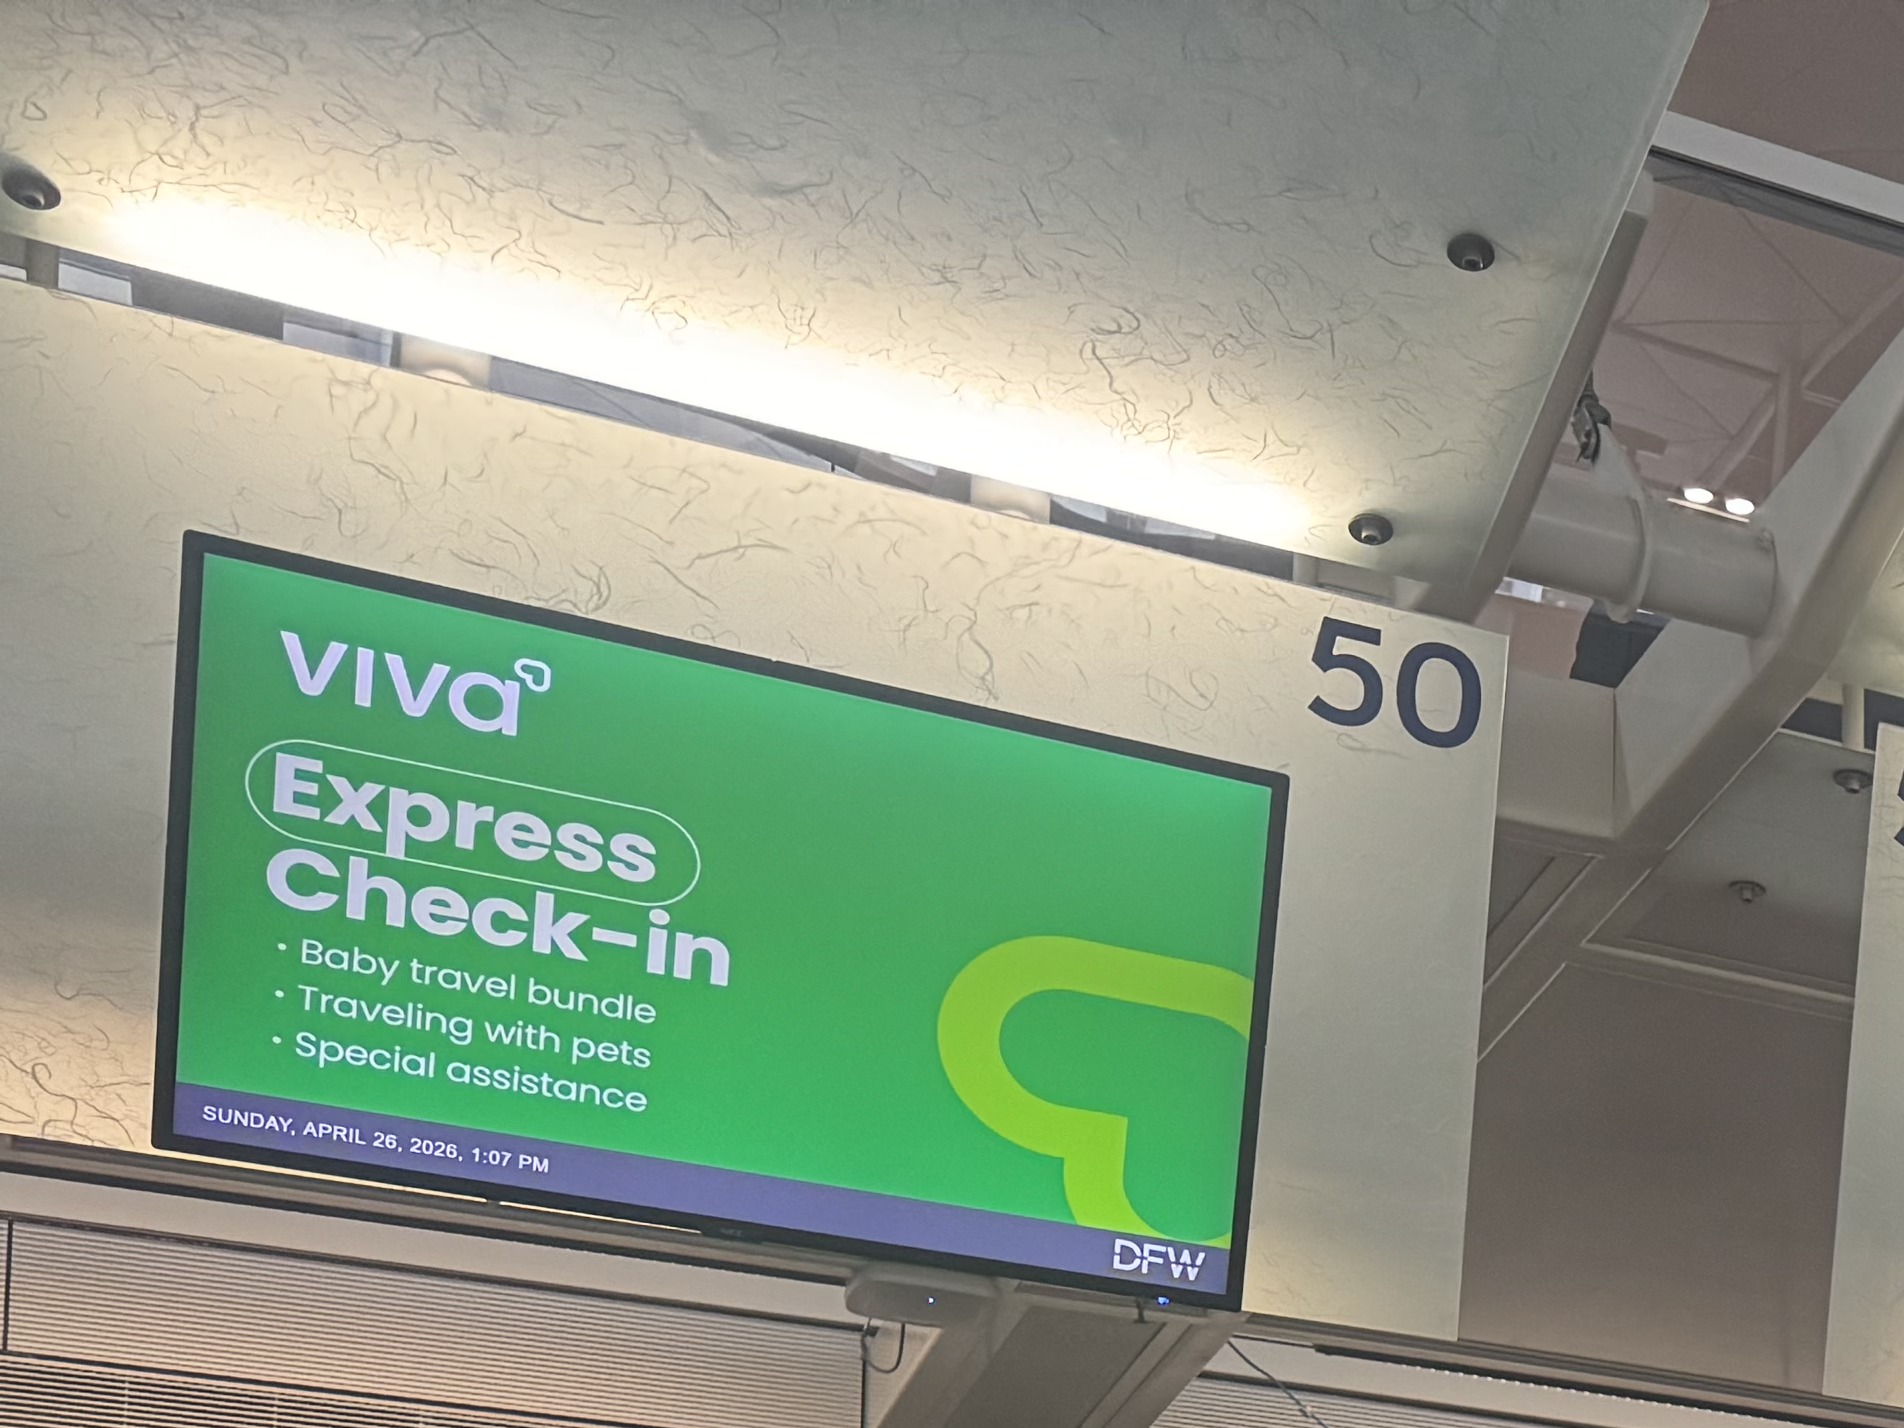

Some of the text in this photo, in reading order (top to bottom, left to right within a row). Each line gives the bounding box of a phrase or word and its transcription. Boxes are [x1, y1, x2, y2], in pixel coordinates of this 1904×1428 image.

[1307, 615, 1484, 750] 50
[272, 752, 657, 883] Express
[266, 848, 730, 986] Check-in
[300, 939, 657, 1025] Baby travel bundle
[297, 985, 652, 1070] Traveling with pets
[294, 1031, 648, 1112] Special assistance
[202, 1104, 551, 1174] SUNDAY, APRIL 26, 2026, 1:07 PM
[1112, 1239, 1206, 1281] DFW
